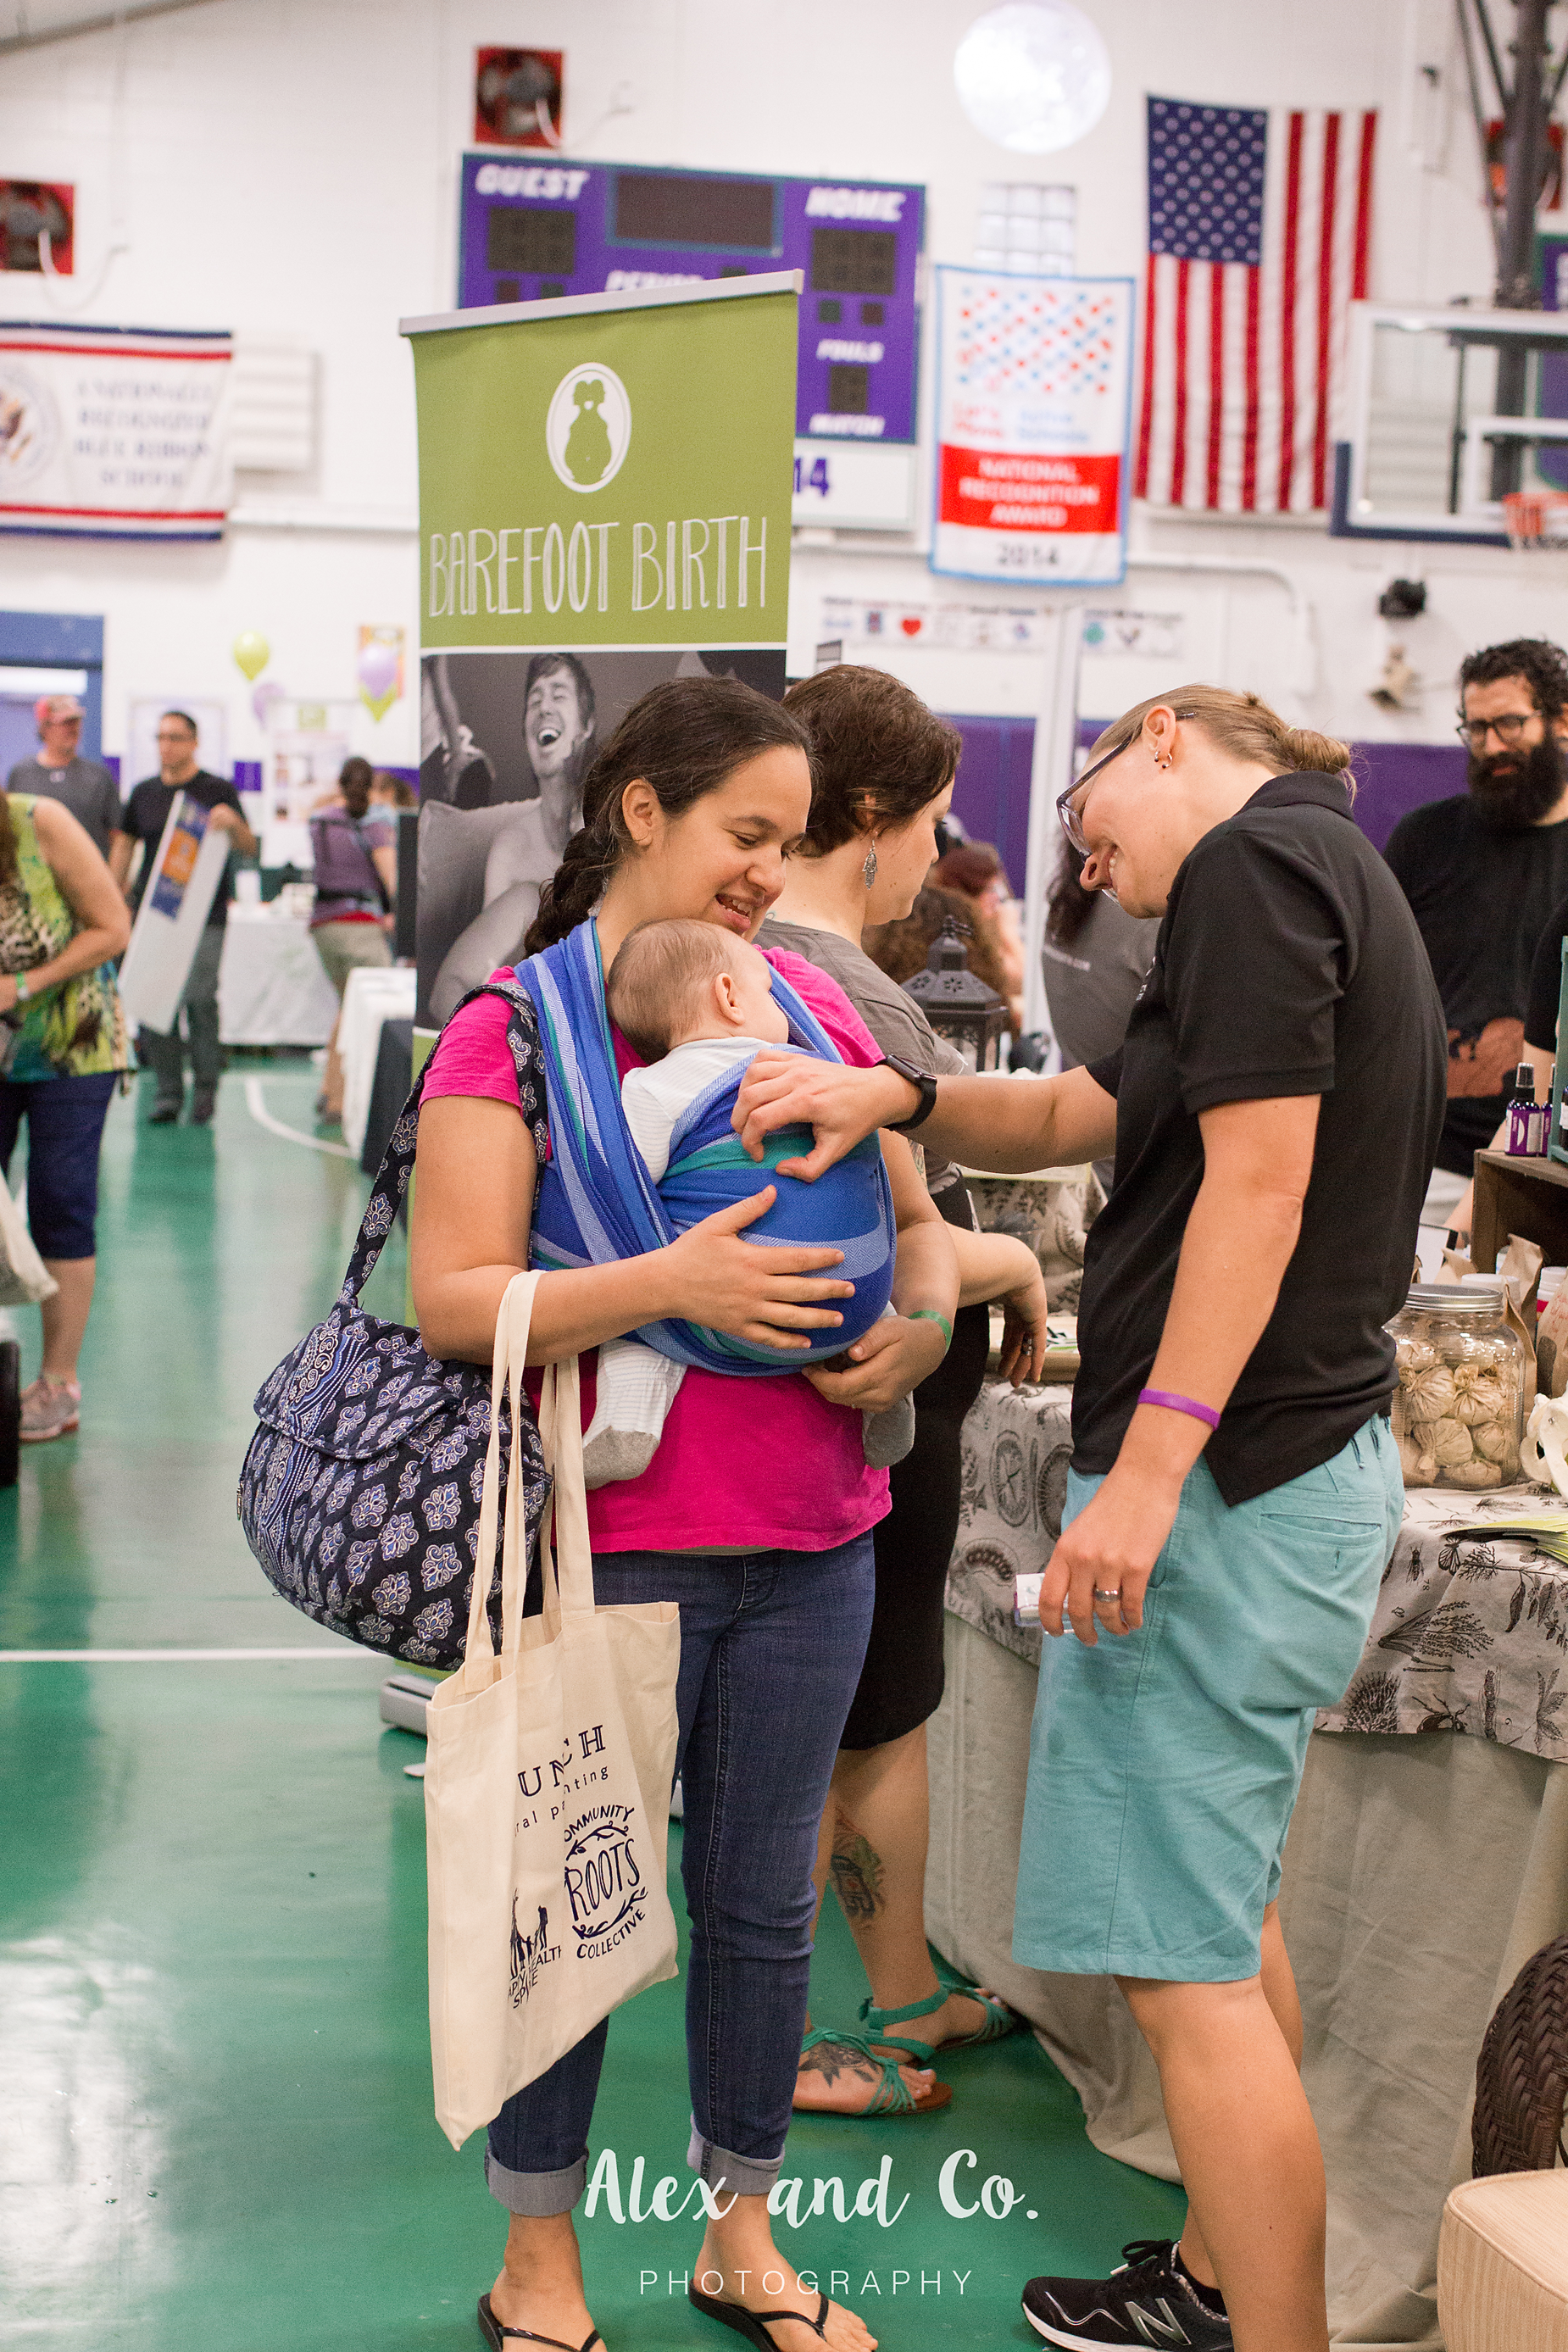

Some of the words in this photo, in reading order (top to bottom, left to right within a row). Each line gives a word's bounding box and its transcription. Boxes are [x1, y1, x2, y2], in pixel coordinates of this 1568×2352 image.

[475, 164, 590, 200] GUEST
[805, 186, 906, 222] HOME
[430, 520, 620, 618] BAREFOOT
[631, 515, 768, 612] BIRTH
[564, 1804, 635, 1843] OMMUNITY
[565, 1838, 641, 1921] ROOTS
[576, 1908, 646, 1960] COLLECTIVE
